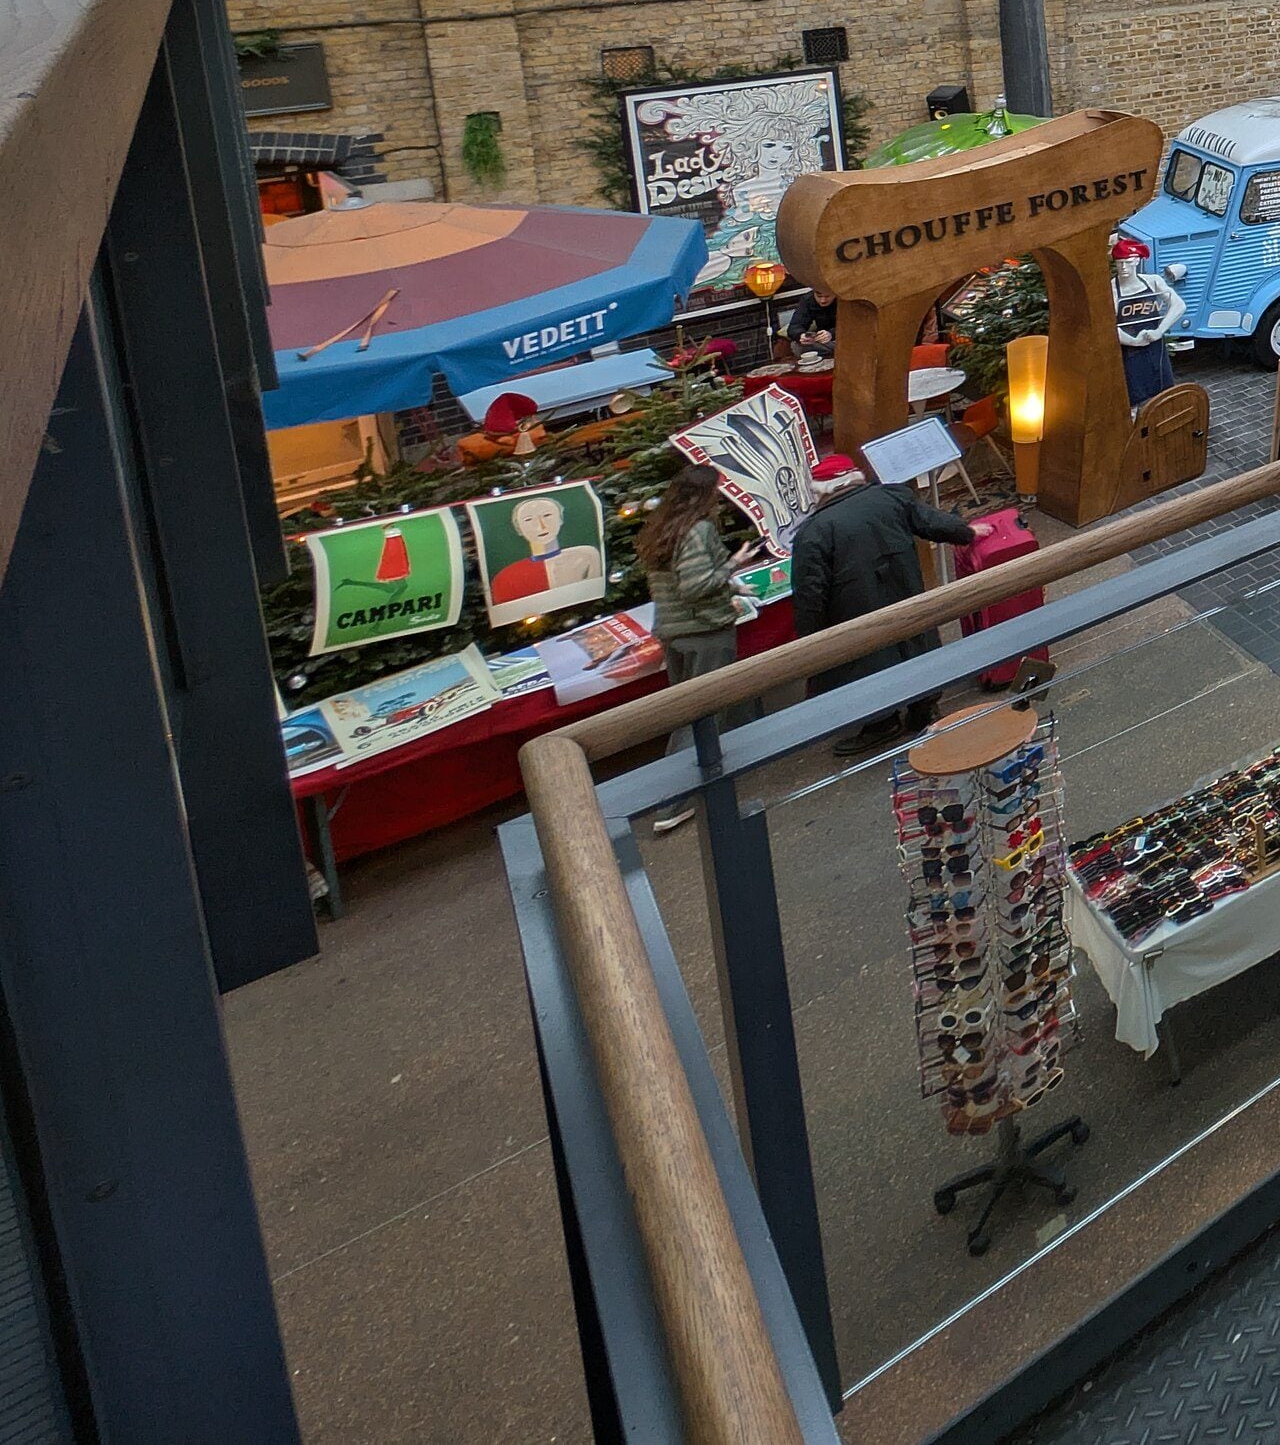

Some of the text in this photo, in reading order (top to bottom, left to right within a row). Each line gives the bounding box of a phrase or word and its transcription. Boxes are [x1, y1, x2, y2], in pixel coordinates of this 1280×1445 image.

[648, 147, 726, 182] Lady
[646, 166, 737, 208] Desire
[836, 202, 1016, 264] CHOUFFE
[1028, 169, 1148, 218] FOREST
[1122, 300, 1164, 316] OPEN
[502, 309, 608, 359] VEDETT
[336, 592, 443, 629] CAMPARI
